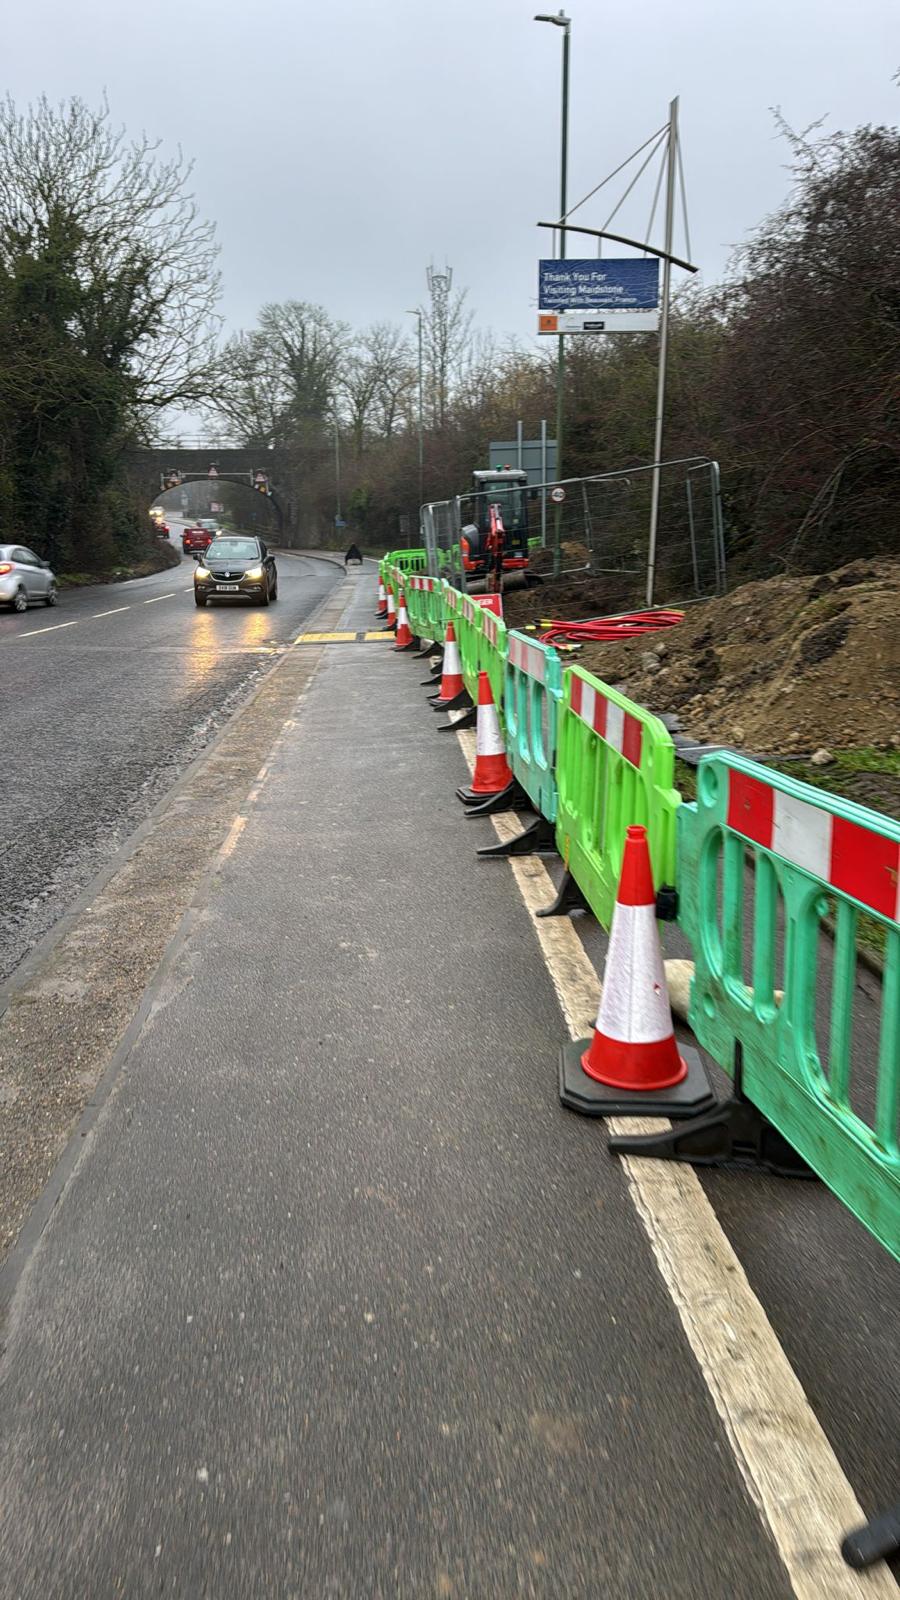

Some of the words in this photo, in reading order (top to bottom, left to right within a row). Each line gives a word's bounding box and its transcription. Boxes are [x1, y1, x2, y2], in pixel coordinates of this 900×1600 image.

[544, 272, 570, 281] Thank
[572, 272, 590, 281] You
[591, 272, 606, 281] For
[544, 286, 577, 296] Visiting
[578, 285, 624, 294] Maidstone
